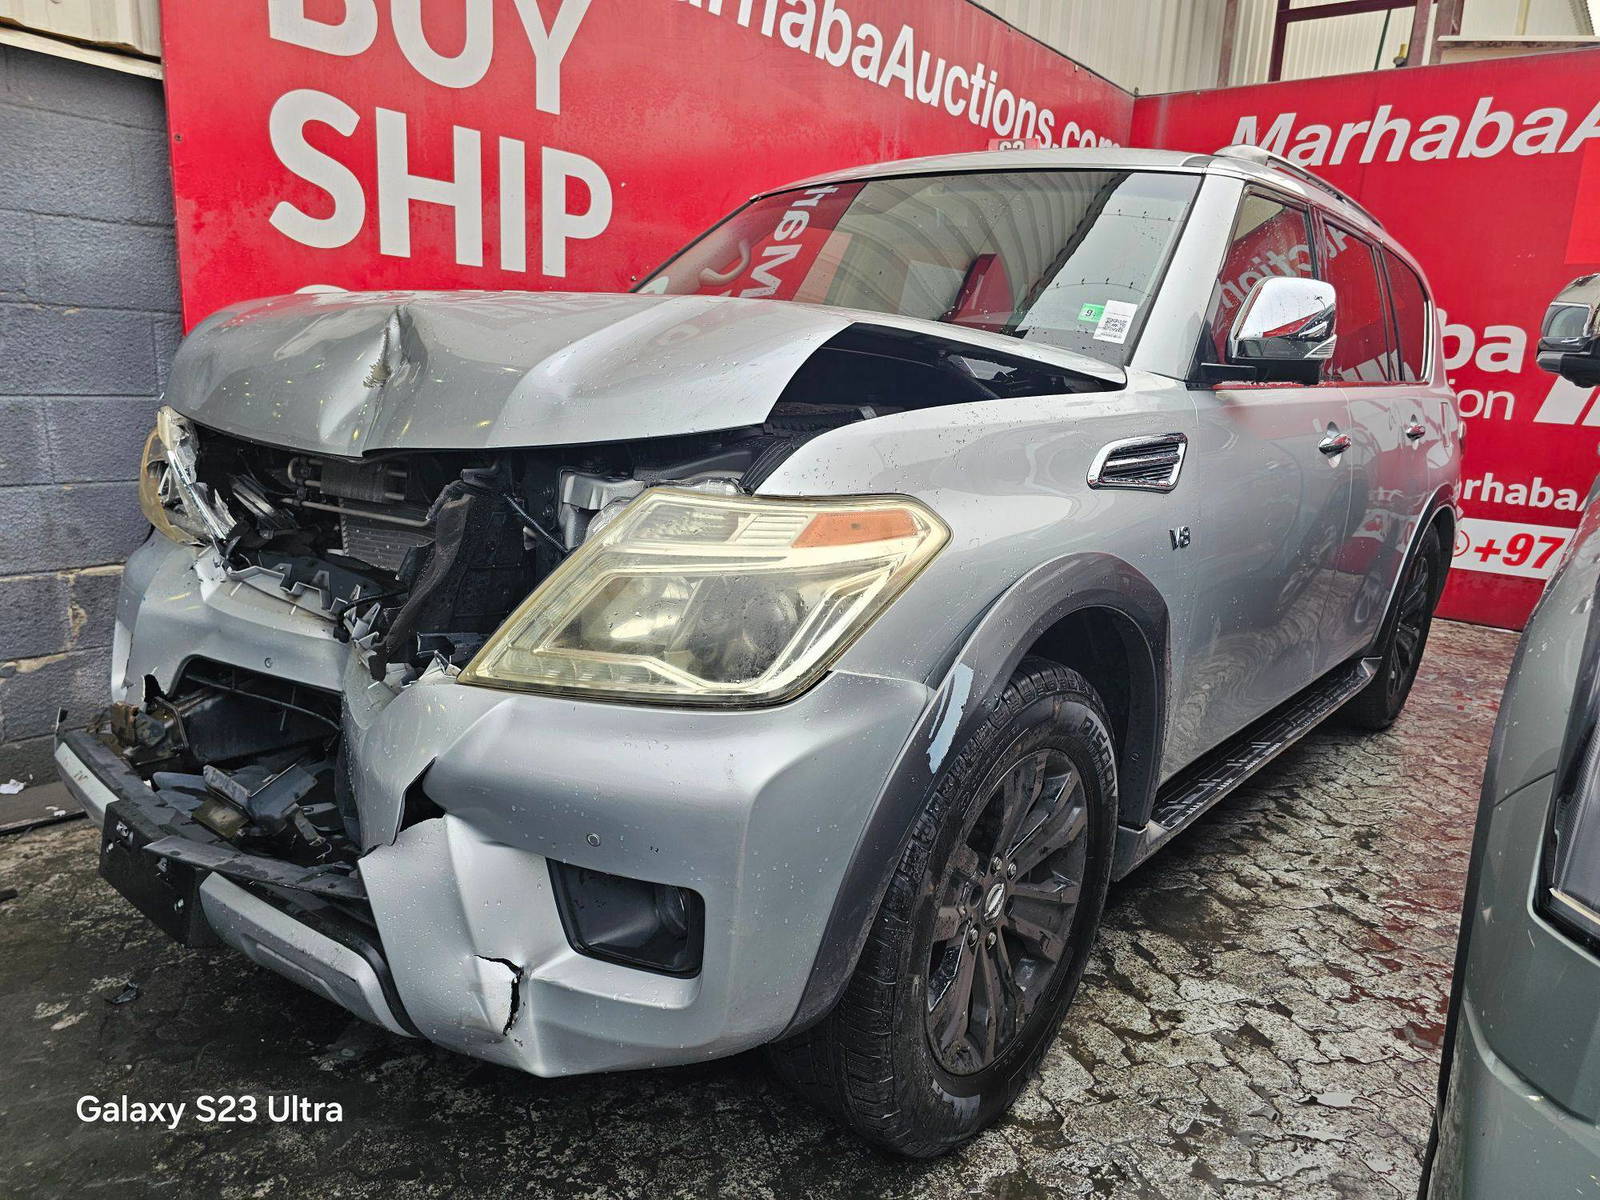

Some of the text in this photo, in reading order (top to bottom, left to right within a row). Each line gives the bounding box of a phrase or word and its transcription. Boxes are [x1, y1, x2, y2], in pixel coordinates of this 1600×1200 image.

[269, 89, 612, 277] SHIP
[1449, 379, 1515, 420] on
[1454, 472, 1588, 512] rhaba
[1169, 526, 1191, 551] V8
[1474, 533, 1565, 569] +97
